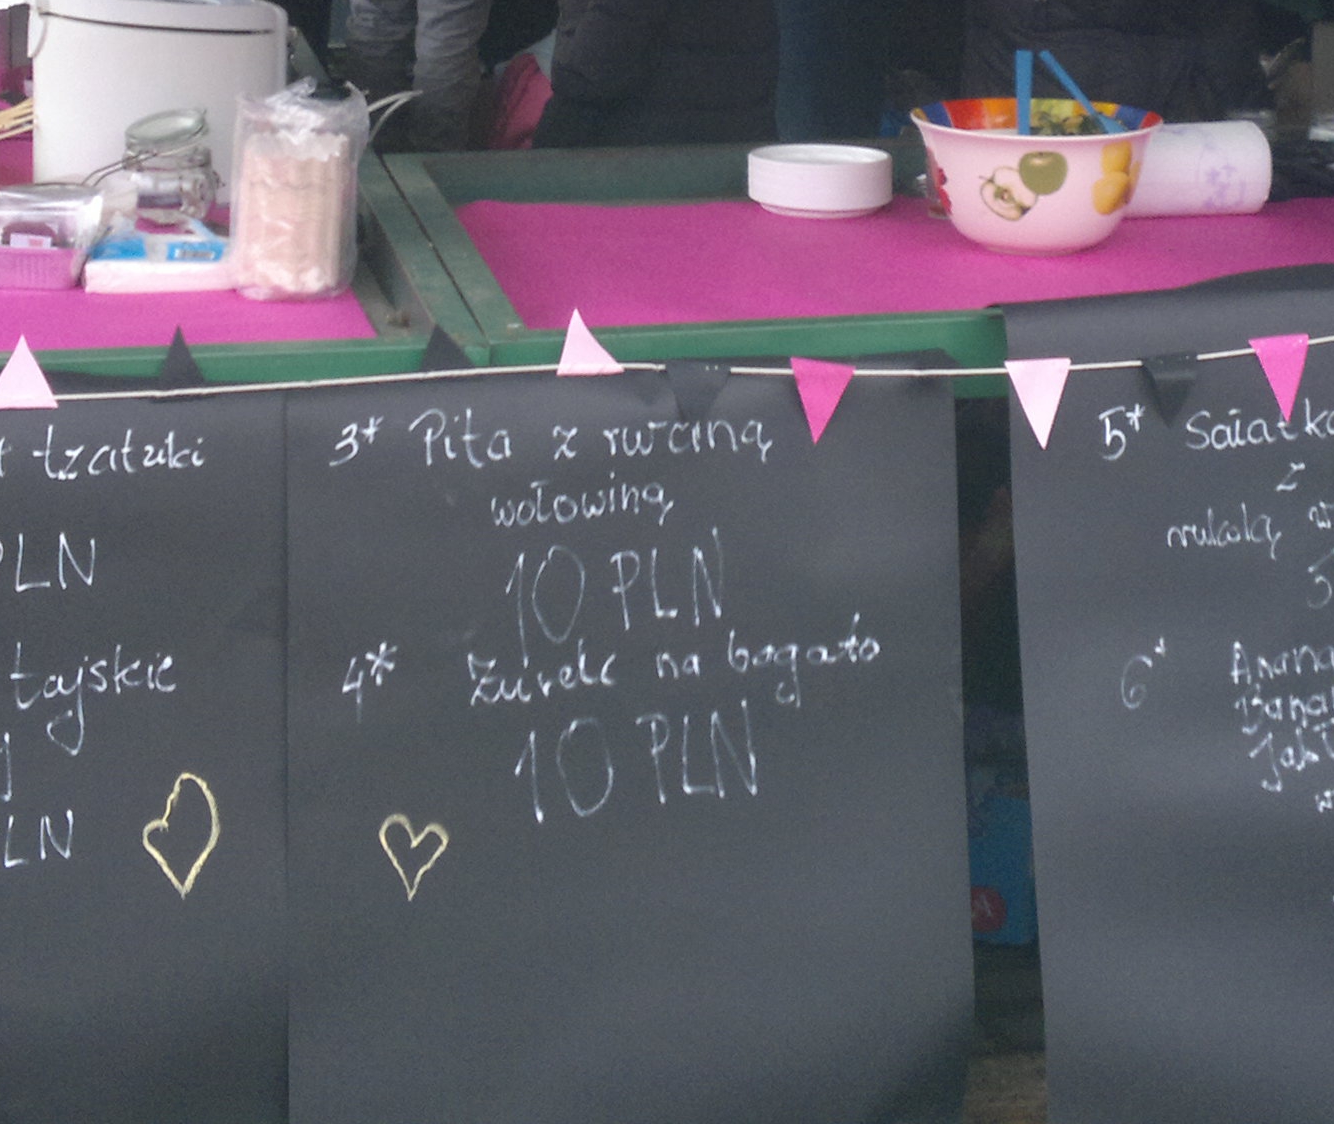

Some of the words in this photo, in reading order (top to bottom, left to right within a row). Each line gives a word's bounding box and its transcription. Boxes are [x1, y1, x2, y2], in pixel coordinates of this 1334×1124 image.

[408, 407, 512, 469] Pita
[552, 426, 578, 461] z
[1274, 462, 1306, 492] z
[8, 641, 177, 758] tajskie
[655, 651, 700, 679] na
[727, 612, 880, 708] bogato
